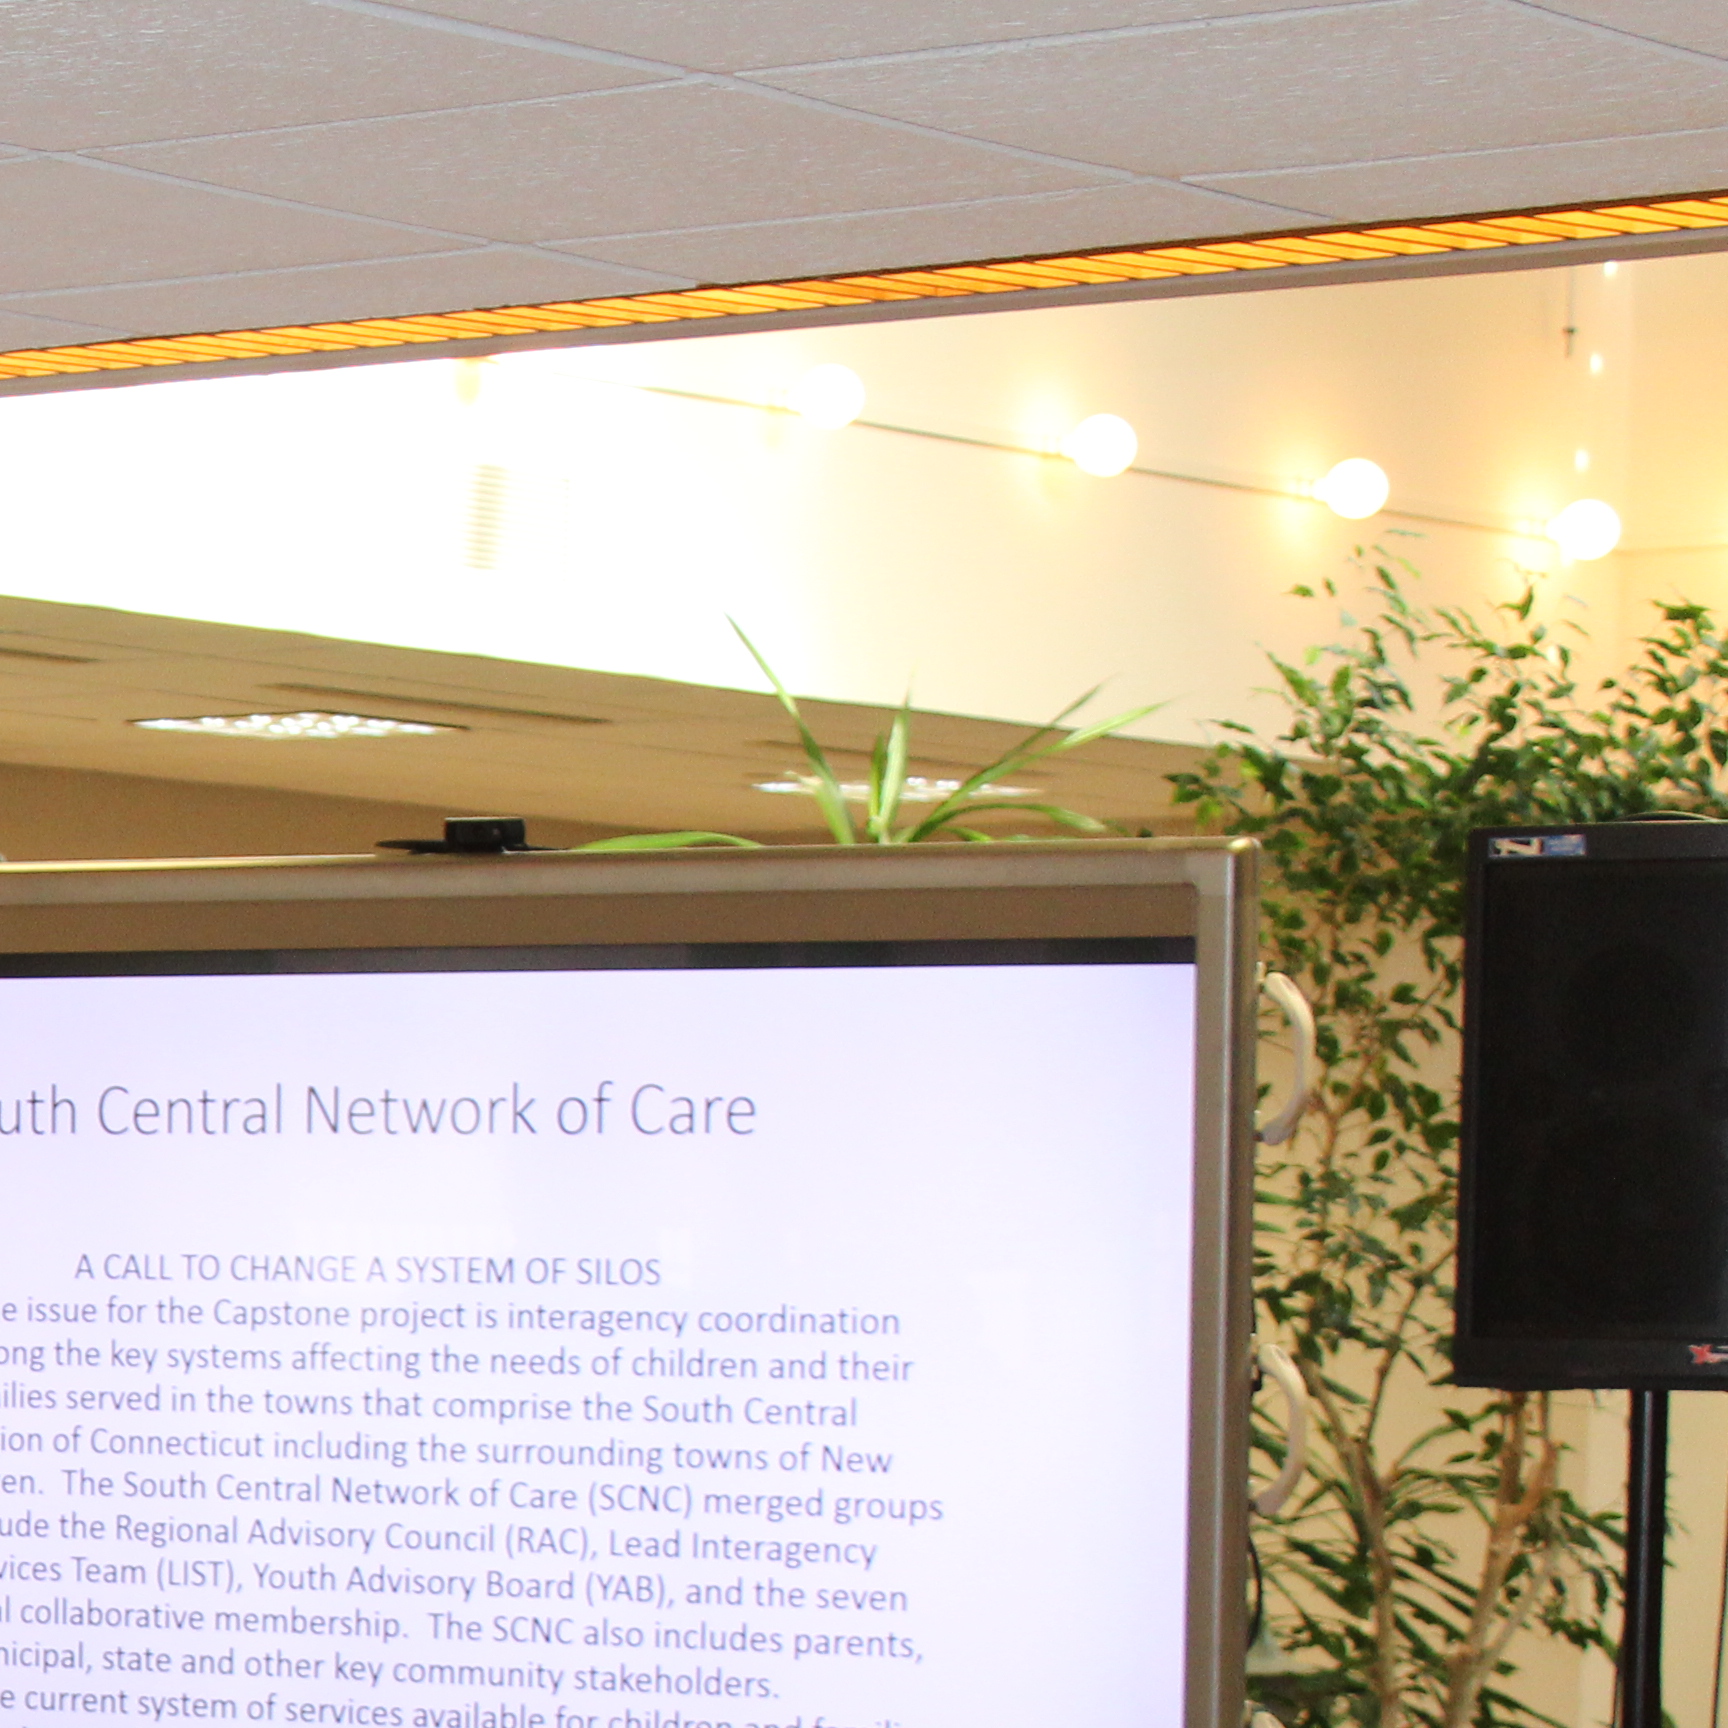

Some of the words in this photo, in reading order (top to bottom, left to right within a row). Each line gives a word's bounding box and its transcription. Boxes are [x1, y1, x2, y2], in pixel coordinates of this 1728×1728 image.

[97, 1082, 282, 1136] Central
[306, 1081, 538, 1136] Network
[556, 1080, 615, 1136] of
[630, 1083, 757, 1136] Care
[74, 1252, 95, 1280] A
[103, 1253, 173, 1281] CALL
[180, 1253, 221, 1282] TO
[230, 1254, 356, 1282] CHANGE
[366, 1256, 387, 1283] A
[396, 1256, 515, 1285] SYSTEM
[525, 1257, 567, 1285] OF
[576, 1257, 662, 1287] SILOS
[27, 1296, 98, 1324] issue
[106, 1294, 147, 1324] for
[156, 1296, 204, 1325] the
[213, 1298, 350, 1332] Capstone
[360, 1301, 466, 1334] project
[476, 1302, 498, 1330] is
[508, 1302, 688, 1339] interagency
[698, 1303, 900, 1335] coordination
[53, 1338, 101, 1367] the
[110, 1339, 158, 1374] key
[167, 1344, 282, 1375] systems
[291, 1341, 421, 1380] affecting
[430, 1344, 480, 1374] the
[490, 1346, 581, 1376] needs
[590, 1346, 623, 1376] of
[631, 1348, 758, 1379] children
[768, 1350, 827, 1380] and
[838, 1351, 913, 1382] their
[66, 1383, 161, 1412] served
[171, 1386, 196, 1412] in
[205, 1384, 254, 1414] the
[263, 1389, 353, 1416] towns
[362, 1387, 423, 1417] that
[432, 1392, 572, 1425] comprise
[582, 1392, 633, 1422] the
[643, 1394, 733, 1424] South
[743, 1397, 857, 1428] Central
[52, 1424, 83, 1454] of
[90, 1427, 263, 1458] Connecticut
[274, 1430, 408, 1468] including
[417, 1433, 466, 1464] the
[477, 1437, 663, 1475] surrounding
[673, 1444, 768, 1471] towns
[778, 1441, 812, 1472] of
[821, 1444, 893, 1475] New
[61, 1467, 114, 1497] The
[123, 1470, 207, 1500] South
[215, 1473, 321, 1503] Central
[331, 1476, 460, 1506] Network
[469, 1478, 501, 1508] of
[509, 1481, 578, 1510] Care
[588, 1482, 693, 1519] (SCNC)
[703, 1488, 824, 1524] merged
[834, 1496, 943, 1526] groups
[58, 1511, 106, 1540] the
[116, 1513, 238, 1549] Regional
[247, 1517, 375, 1555] Advisory
[384, 1522, 495, 1552] Council
[505, 1524, 598, 1561] (RAC),
[609, 1529, 681, 1559] Lead
[692, 1533, 877, 1571] Interagency
[70, 1555, 147, 1585] Team
[156, 1557, 243, 1594] (LIST),
[253, 1562, 336, 1592] Youth
[345, 1564, 476, 1603] Advisory
[486, 1570, 575, 1601] Board
[585, 1571, 674, 1609] (YAB),
[685, 1576, 743, 1606] and
[753, 1577, 806, 1608] the
[816, 1588, 907, 1612] seven
[20, 1597, 205, 1631] collaborative
[214, 1605, 409, 1645] membership.
[427, 1611, 483, 1642] The
[493, 1615, 573, 1646] SCNC
[583, 1618, 645, 1648] also
[654, 1620, 784, 1654] includes
[793, 1632, 922, 1663] parents,
[101, 1646, 172, 1674] state
[181, 1647, 234, 1675] and
[244, 1649, 325, 1680] other
[334, 1651, 384, 1688] key
[392, 1662, 564, 1696] community
[574, 1663, 779, 1699] stakeholders.
[24, 1689, 129, 1715] current
[137, 1692, 238, 1723] system
[246, 1692, 278, 1721] of
[285, 1698, 403, 1728] services
